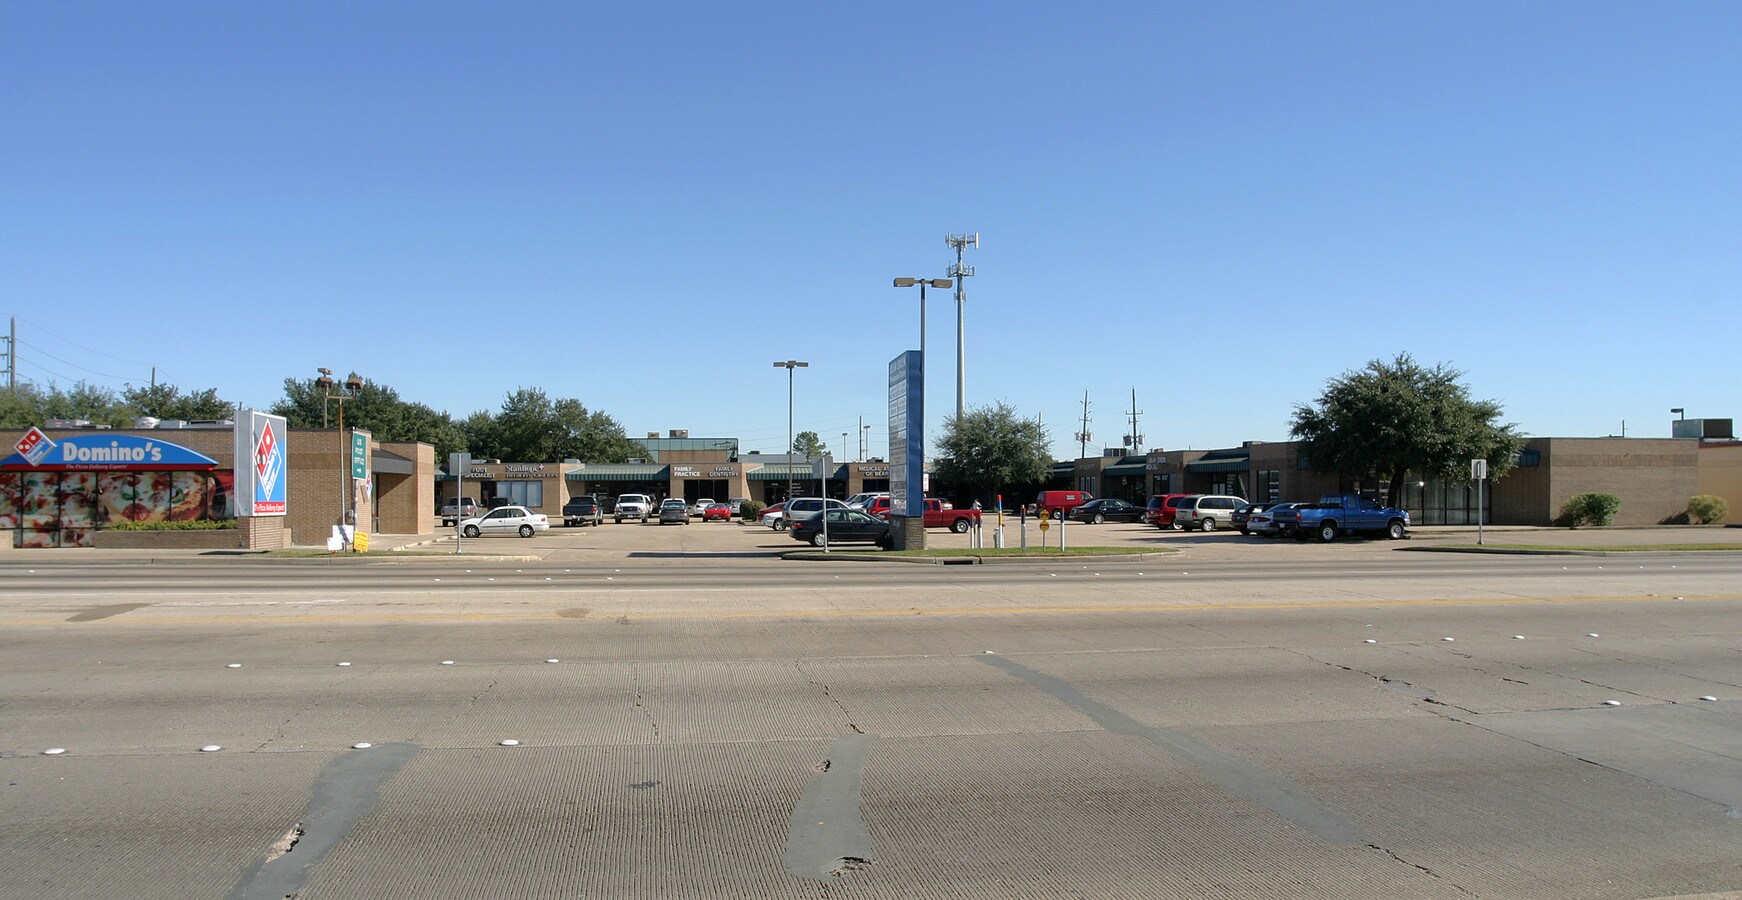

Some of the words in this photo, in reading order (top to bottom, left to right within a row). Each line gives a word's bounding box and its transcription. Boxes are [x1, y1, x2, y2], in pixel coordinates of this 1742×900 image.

[356, 438, 363, 446] US
[63, 441, 162, 462] Domino's
[355, 447, 364, 455] POST
[354, 456, 365, 466] OFFICE
[505, 465, 539, 474] Stanhope
